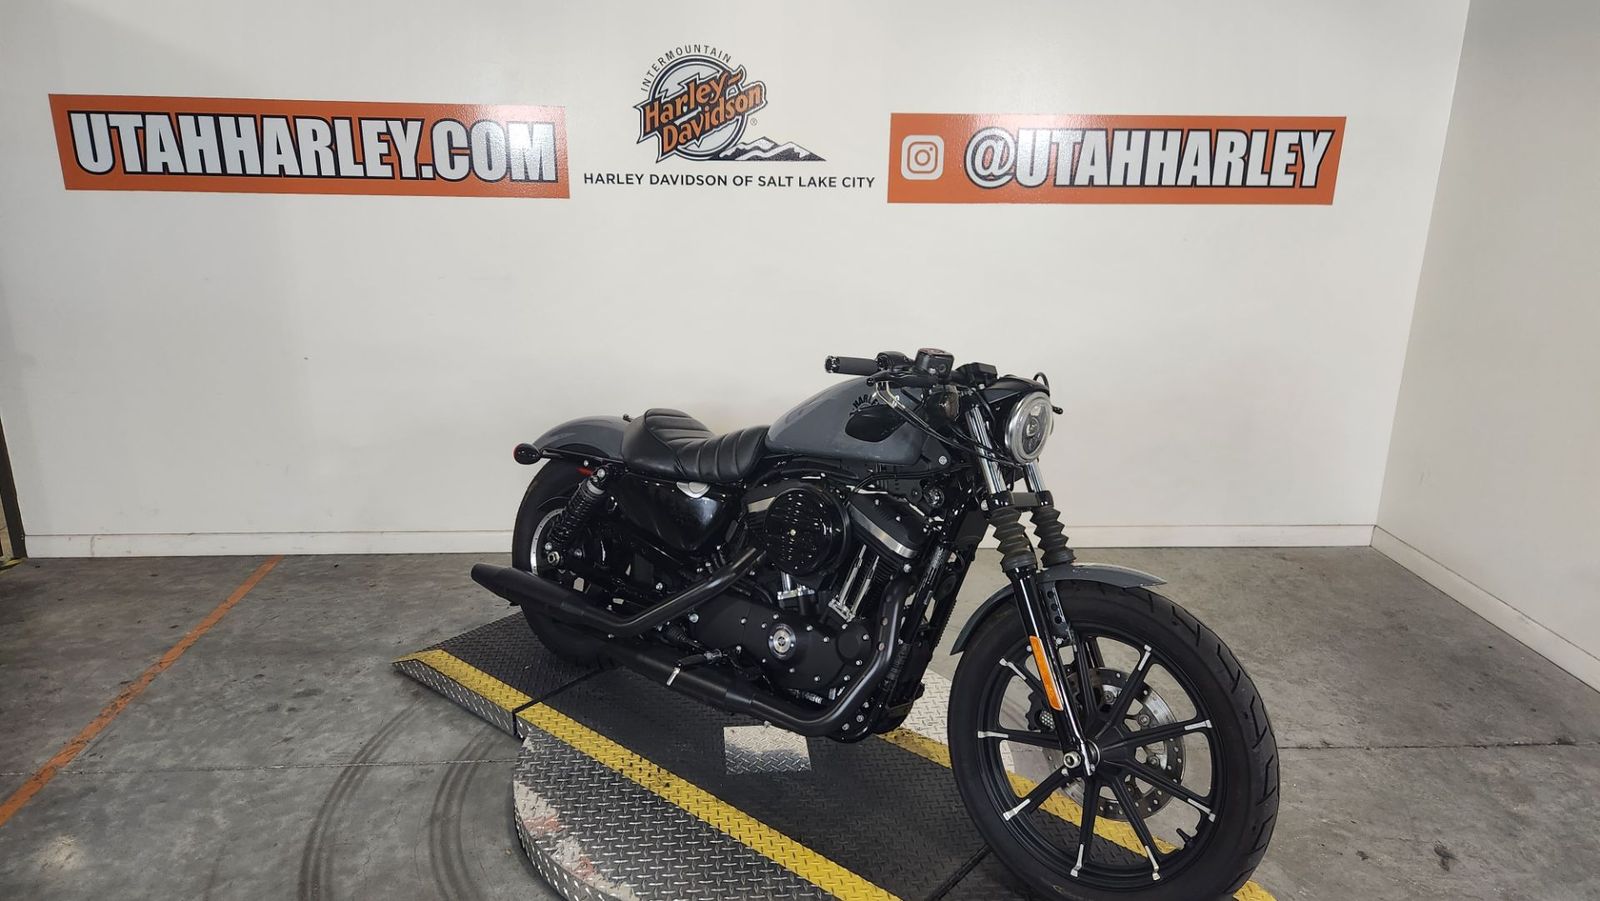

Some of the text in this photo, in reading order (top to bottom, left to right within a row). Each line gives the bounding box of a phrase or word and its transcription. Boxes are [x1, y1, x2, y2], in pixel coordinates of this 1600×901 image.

[640, 44, 732, 92] INTERMOUNTAIN
[67, 110, 559, 183] UTAHHARLEY.COM
[662, 83, 761, 153] Davidson
[583, 172, 875, 188] HARLEY DAVIDSON OF SALT LAKE CITY
[964, 126, 1336, 189] @UTAHHARLEY
